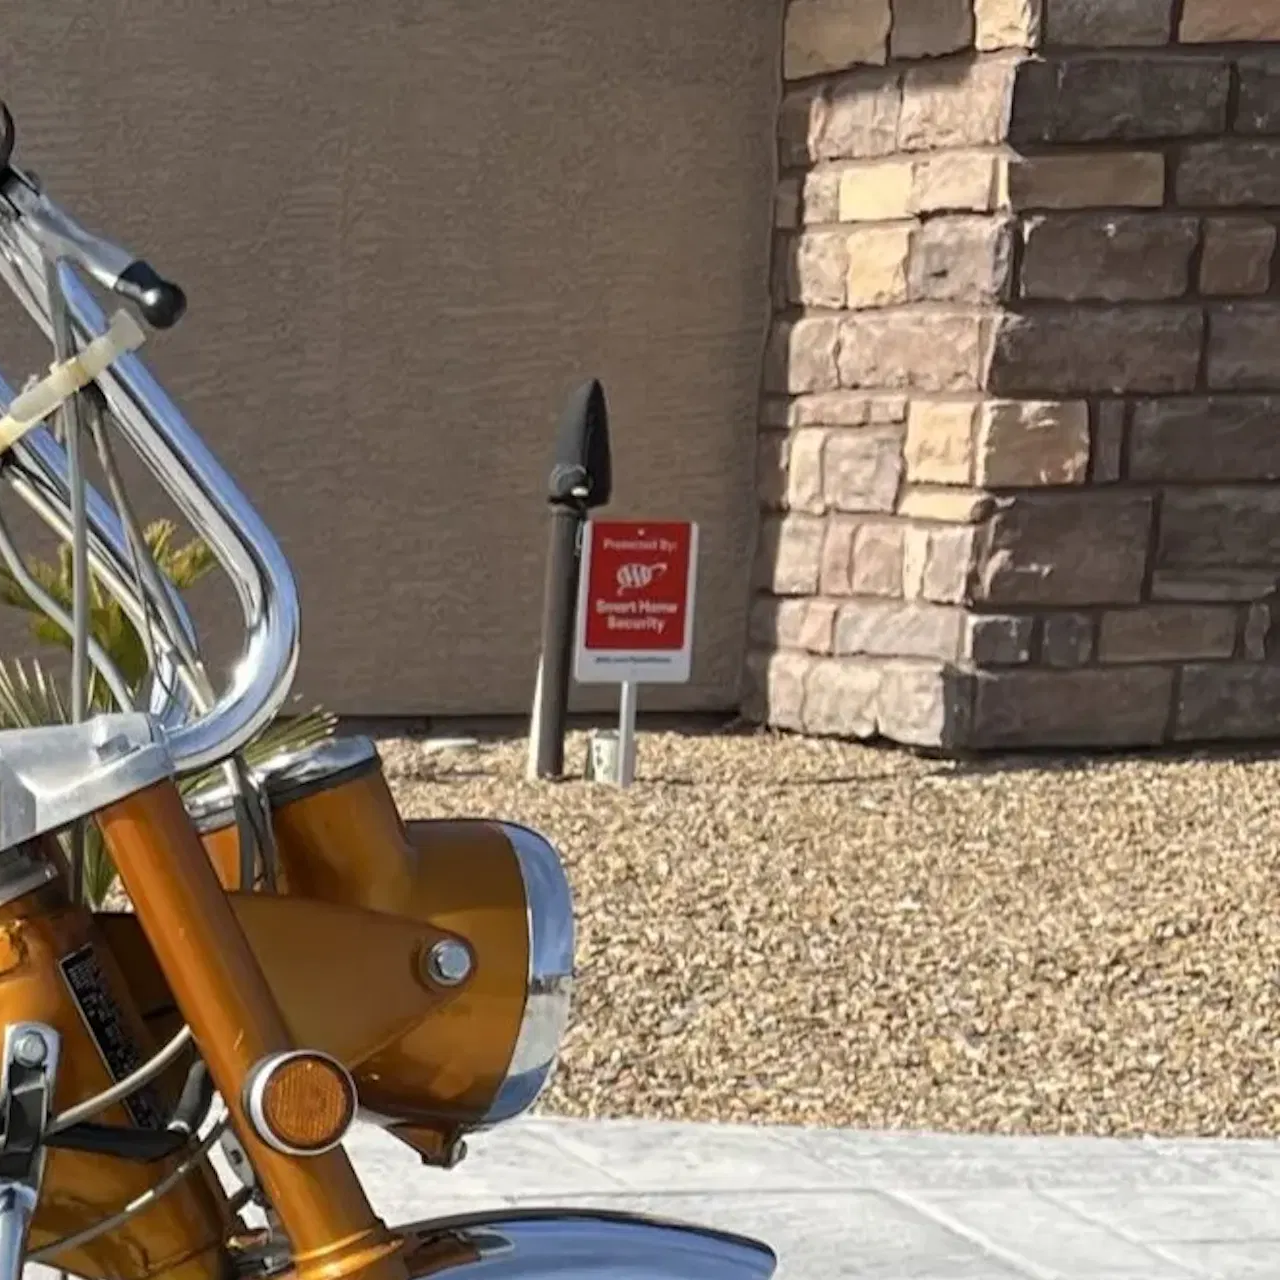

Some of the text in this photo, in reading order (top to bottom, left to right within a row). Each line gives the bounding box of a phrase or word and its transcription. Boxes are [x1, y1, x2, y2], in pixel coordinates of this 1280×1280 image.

[596, 598, 678, 614] Smart Home
[606, 615, 666, 634] Security
